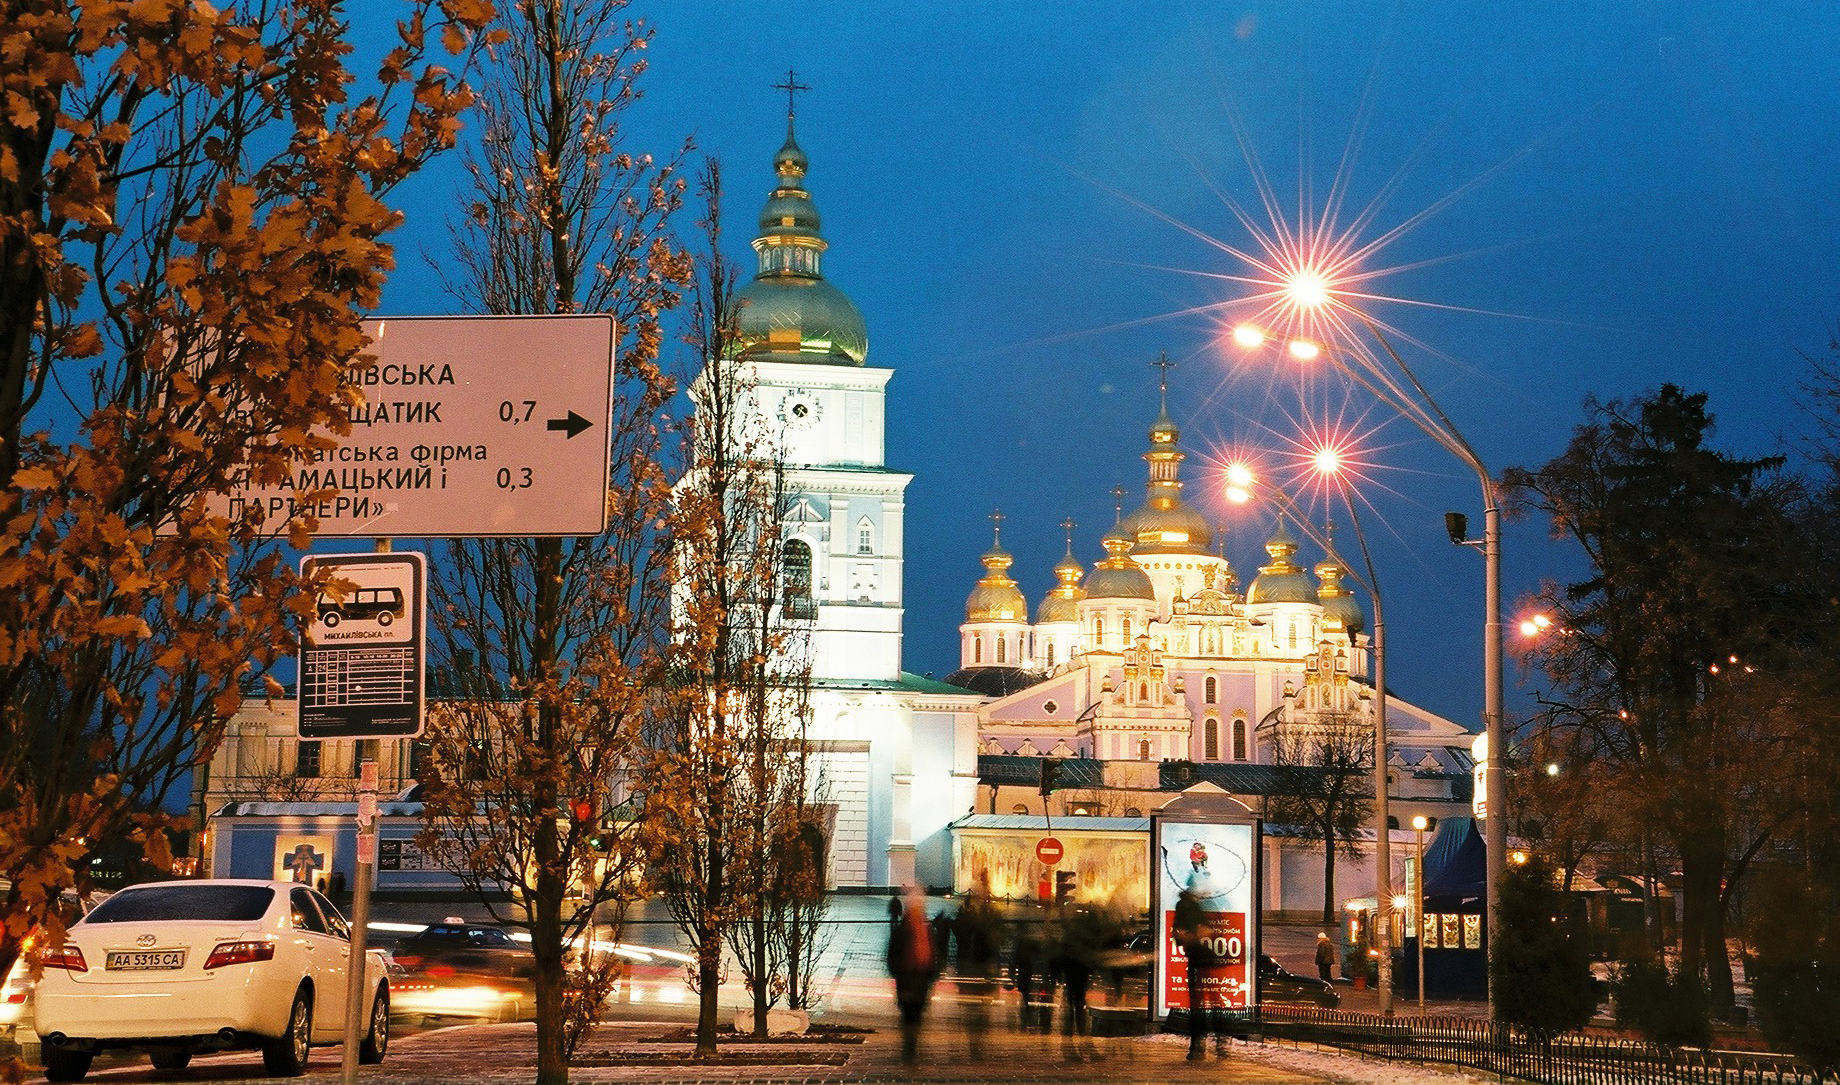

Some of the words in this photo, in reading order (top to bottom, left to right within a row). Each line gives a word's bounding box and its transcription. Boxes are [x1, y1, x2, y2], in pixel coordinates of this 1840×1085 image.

[347, 401, 441, 427] ЩАТИК
[499, 401, 536, 425] 0,7
[410, 444, 487, 467] фірма
[441, 468, 447, 489] і
[497, 467, 533, 492] 0,3
[115, 955, 131, 966] AA
[134, 954, 160, 965] 5315
[163, 954, 179, 965] CA
